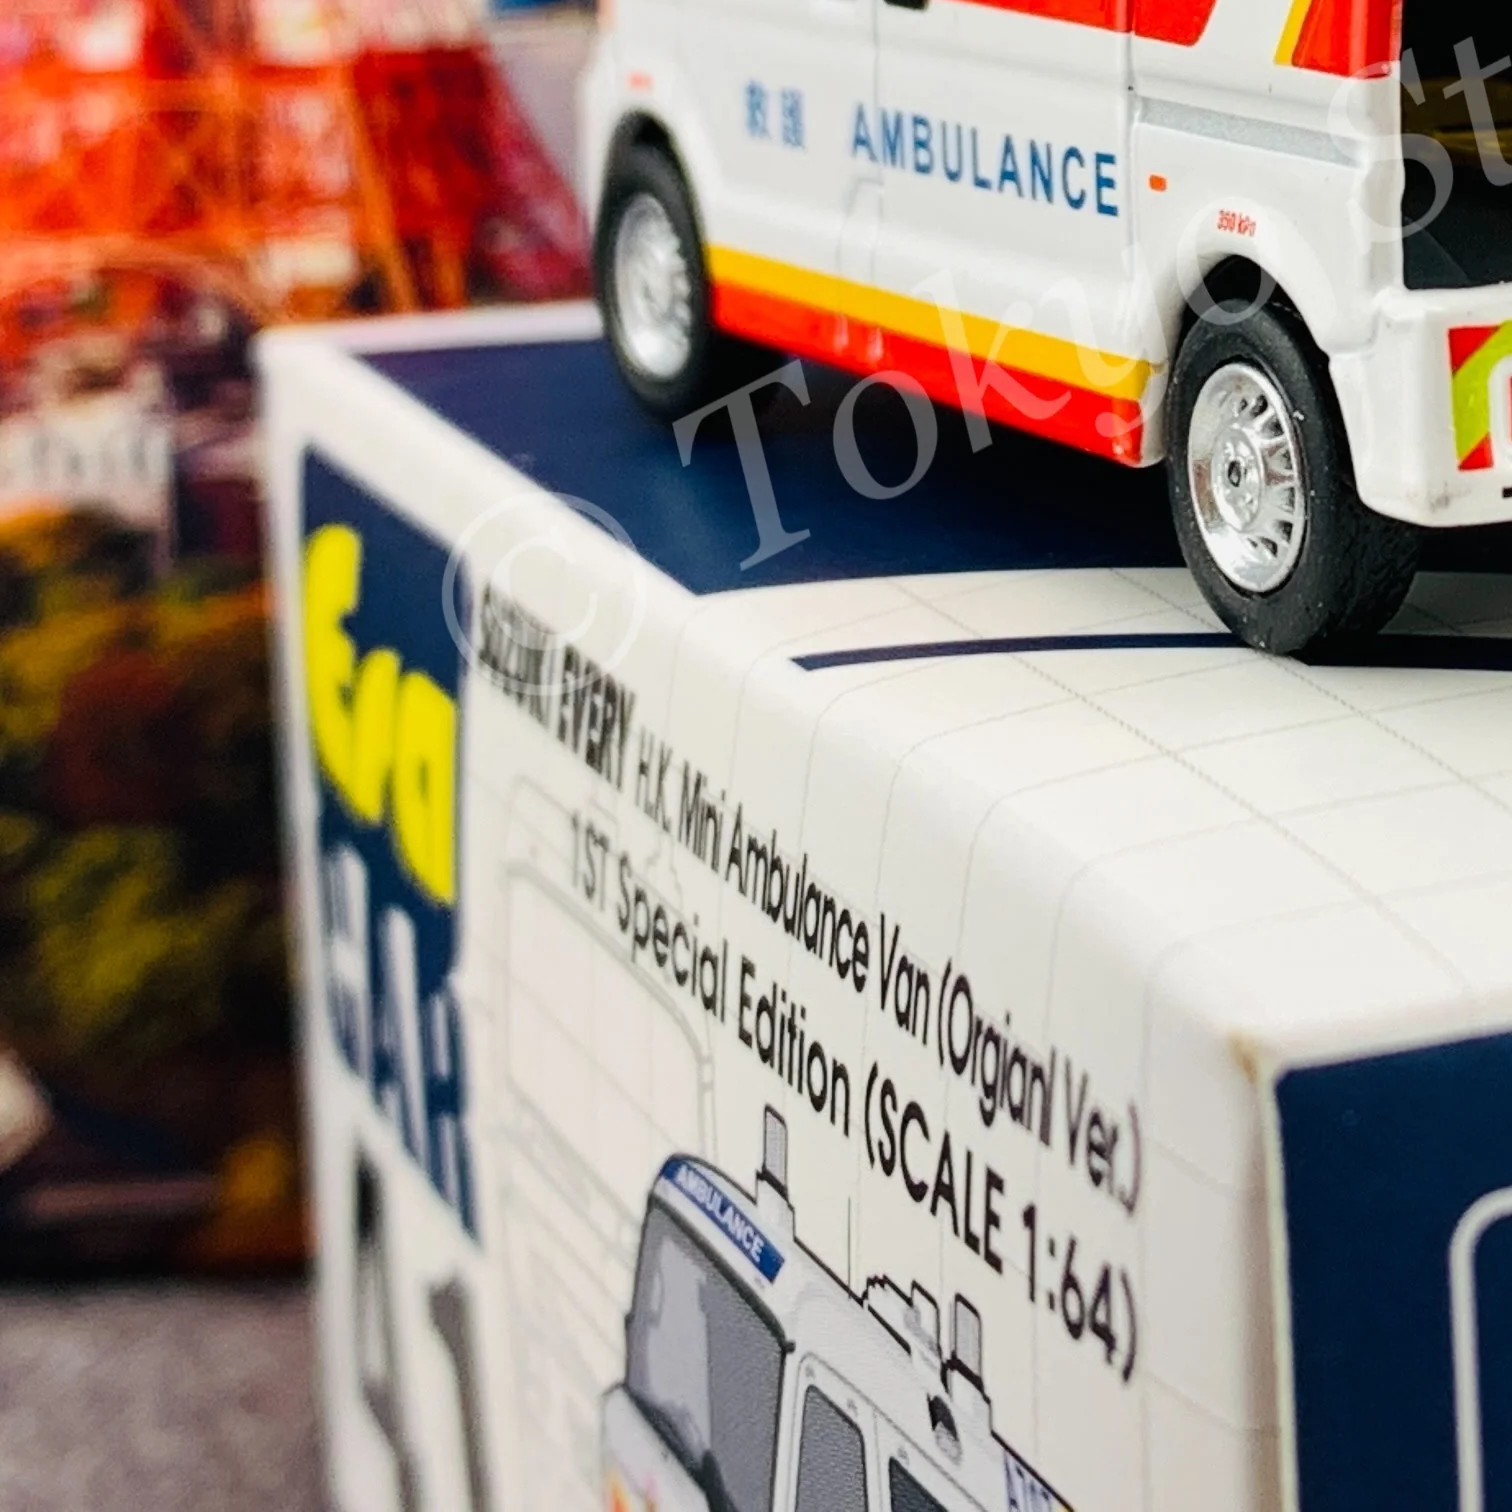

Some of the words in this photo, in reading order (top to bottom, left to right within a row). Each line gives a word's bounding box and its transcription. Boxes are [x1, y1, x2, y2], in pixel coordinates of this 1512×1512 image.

[851, 102, 1119, 218] AMBULANCE
[557, 644, 636, 794] EVERY
[678, 760, 727, 874] Mini
[726, 802, 870, 993] Ambulance
[880, 911, 931, 1046] Van
[571, 808, 611, 901] 1ST
[616, 850, 729, 1025] Special
[739, 953, 851, 1139] Edition
[864, 1060, 1004, 1276] (SCALE
[1022, 1202, 1139, 1386] 1:64)
[675, 1163, 765, 1263] AMBULANCE
